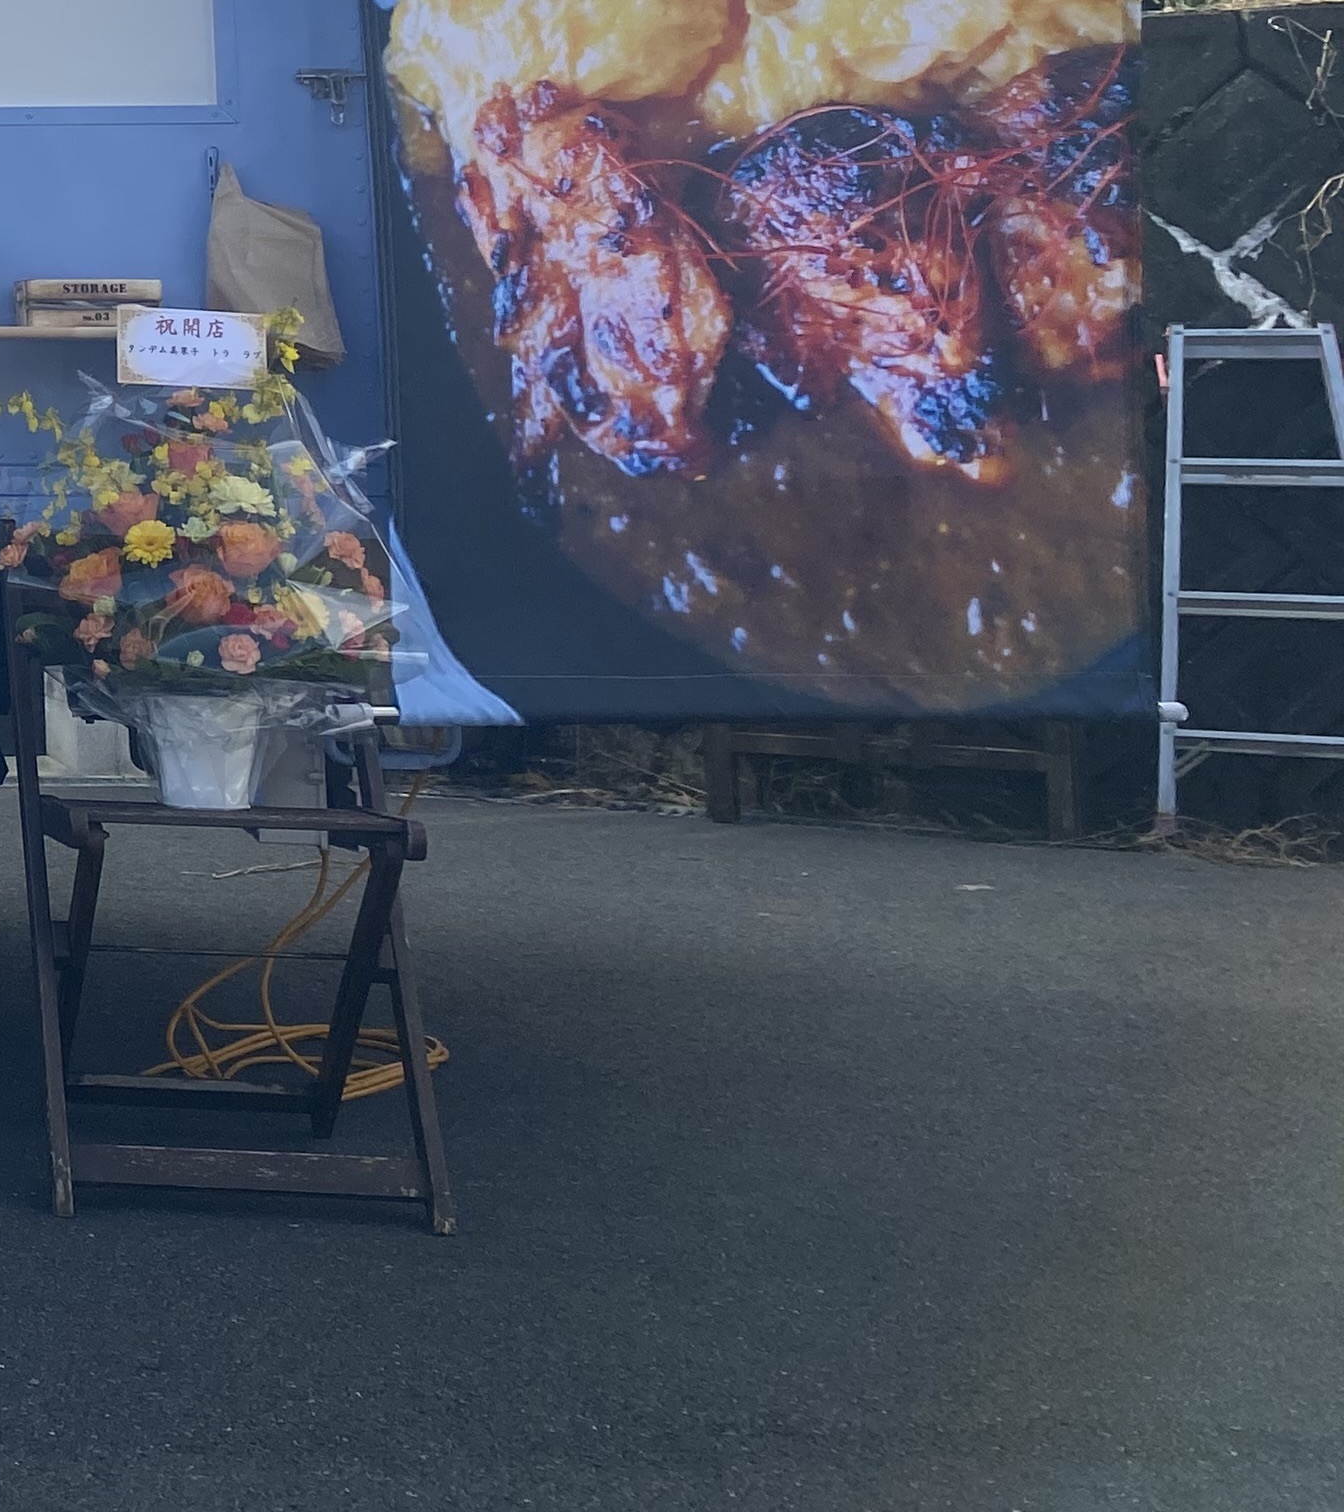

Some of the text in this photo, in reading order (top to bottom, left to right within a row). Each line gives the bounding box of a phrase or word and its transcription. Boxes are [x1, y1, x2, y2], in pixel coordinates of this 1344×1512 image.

[62, 283, 128, 294] STORAGE
[155, 315, 225, 339] 祝開店
